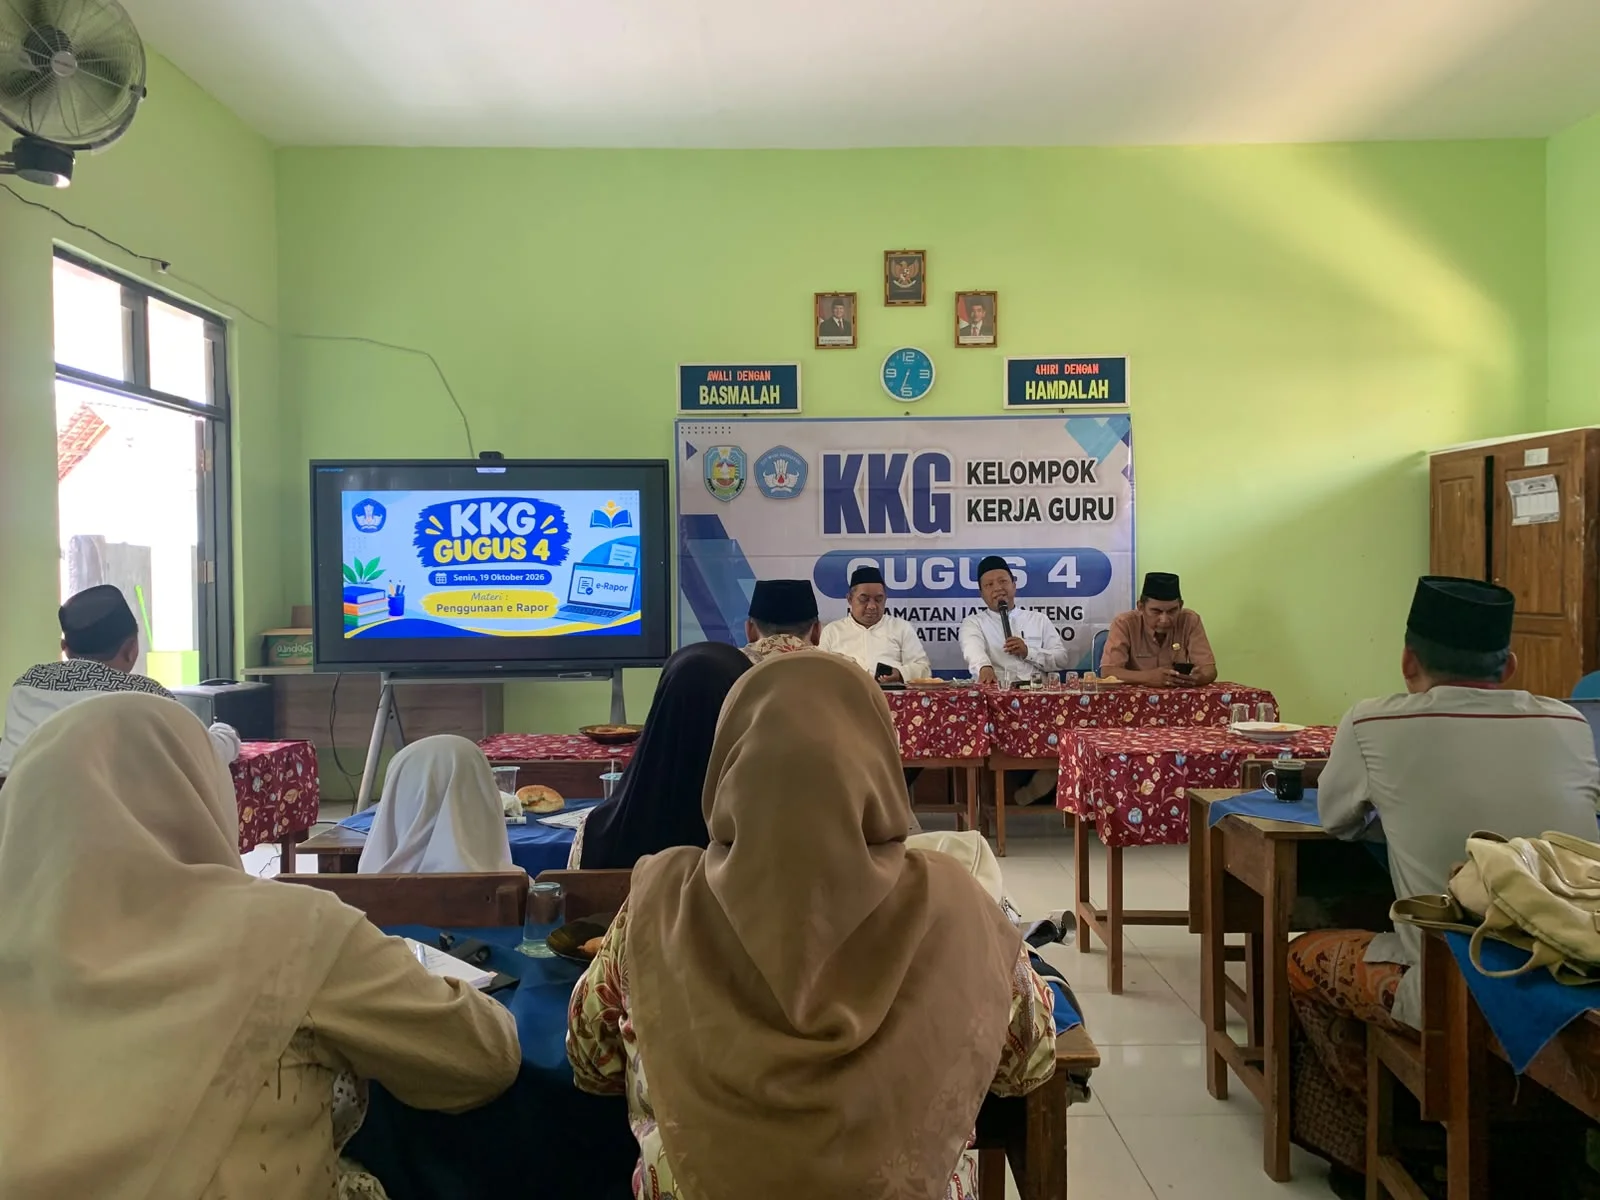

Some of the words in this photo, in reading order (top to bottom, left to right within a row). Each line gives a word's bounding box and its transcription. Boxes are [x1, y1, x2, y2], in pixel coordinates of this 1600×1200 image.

[902, 352, 915, 362] 12
[885, 368, 897, 378] 9
[919, 369, 930, 379] 3
[1064, 363, 1099, 374] DENGAN
[707, 370, 732, 381] AWALI
[737, 370, 771, 381] DENGAN
[700, 384, 780, 405] BASMALAH
[901, 387, 913, 397] 6
[1025, 379, 1109, 400] HAMDALAH
[967, 459, 1096, 485] KELOMPOK
[823, 452, 951, 534] KKG
[967, 498, 1041, 522] KERJA
[1048, 497, 1114, 521] GURU
[450, 501, 536, 537] KKG
[433, 536, 527, 563] GUGUS
[532, 538, 551, 561] 4
[453, 573, 478, 582] Senin,
[480, 573, 489, 581] 19
[490, 573, 524, 581] Oktober
[525, 573, 545, 581] 2026
[1047, 555, 1081, 589] 4
[595, 582, 628, 592] e-Rapor
[470, 592, 503, 601] Materi
[436, 603, 504, 615] Penggunaan
[516, 603, 549, 614] Rapor
